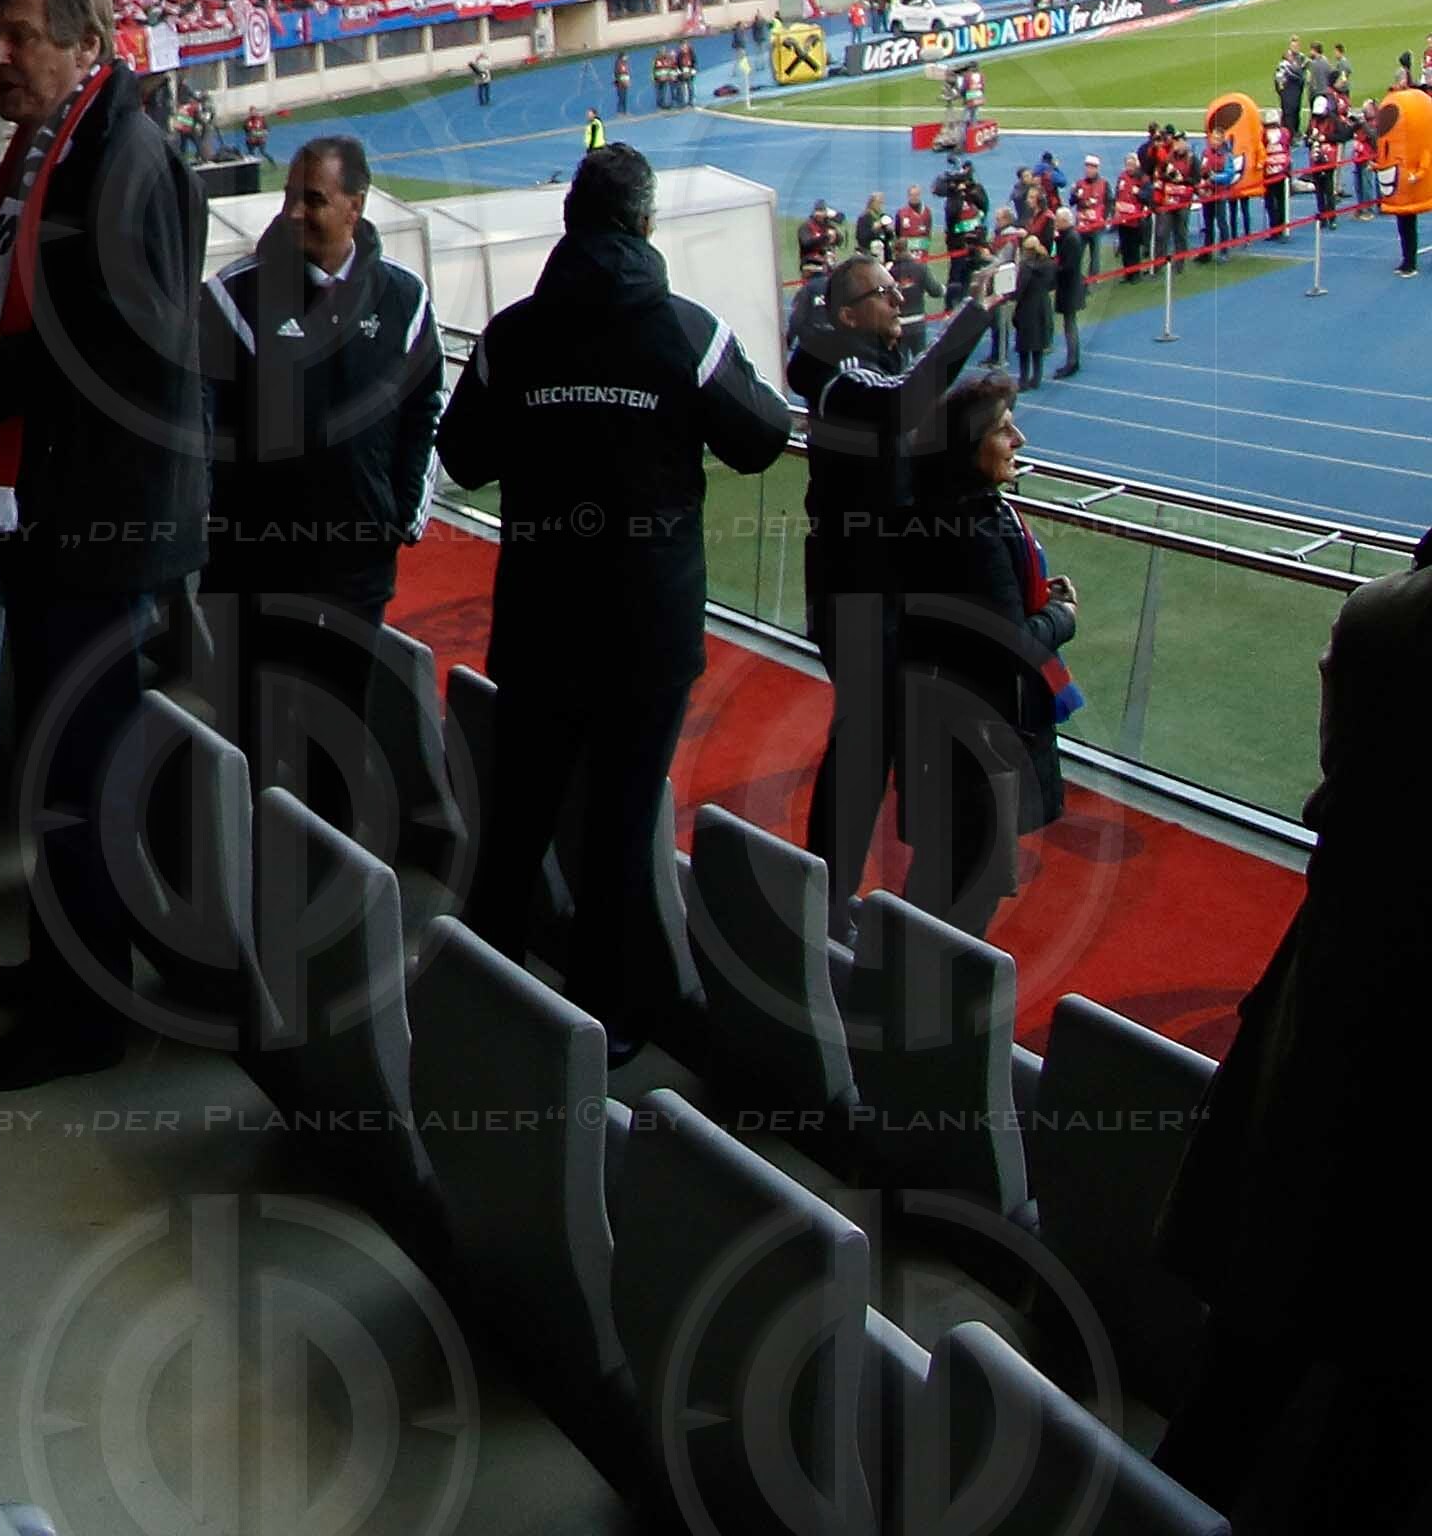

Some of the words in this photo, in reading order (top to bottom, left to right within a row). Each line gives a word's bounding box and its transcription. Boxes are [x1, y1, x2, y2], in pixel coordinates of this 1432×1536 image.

[863, 39, 919, 71] UEFA
[1068, 5, 1090, 34] for
[525, 385, 660, 410] LIECHTENSTEIN
